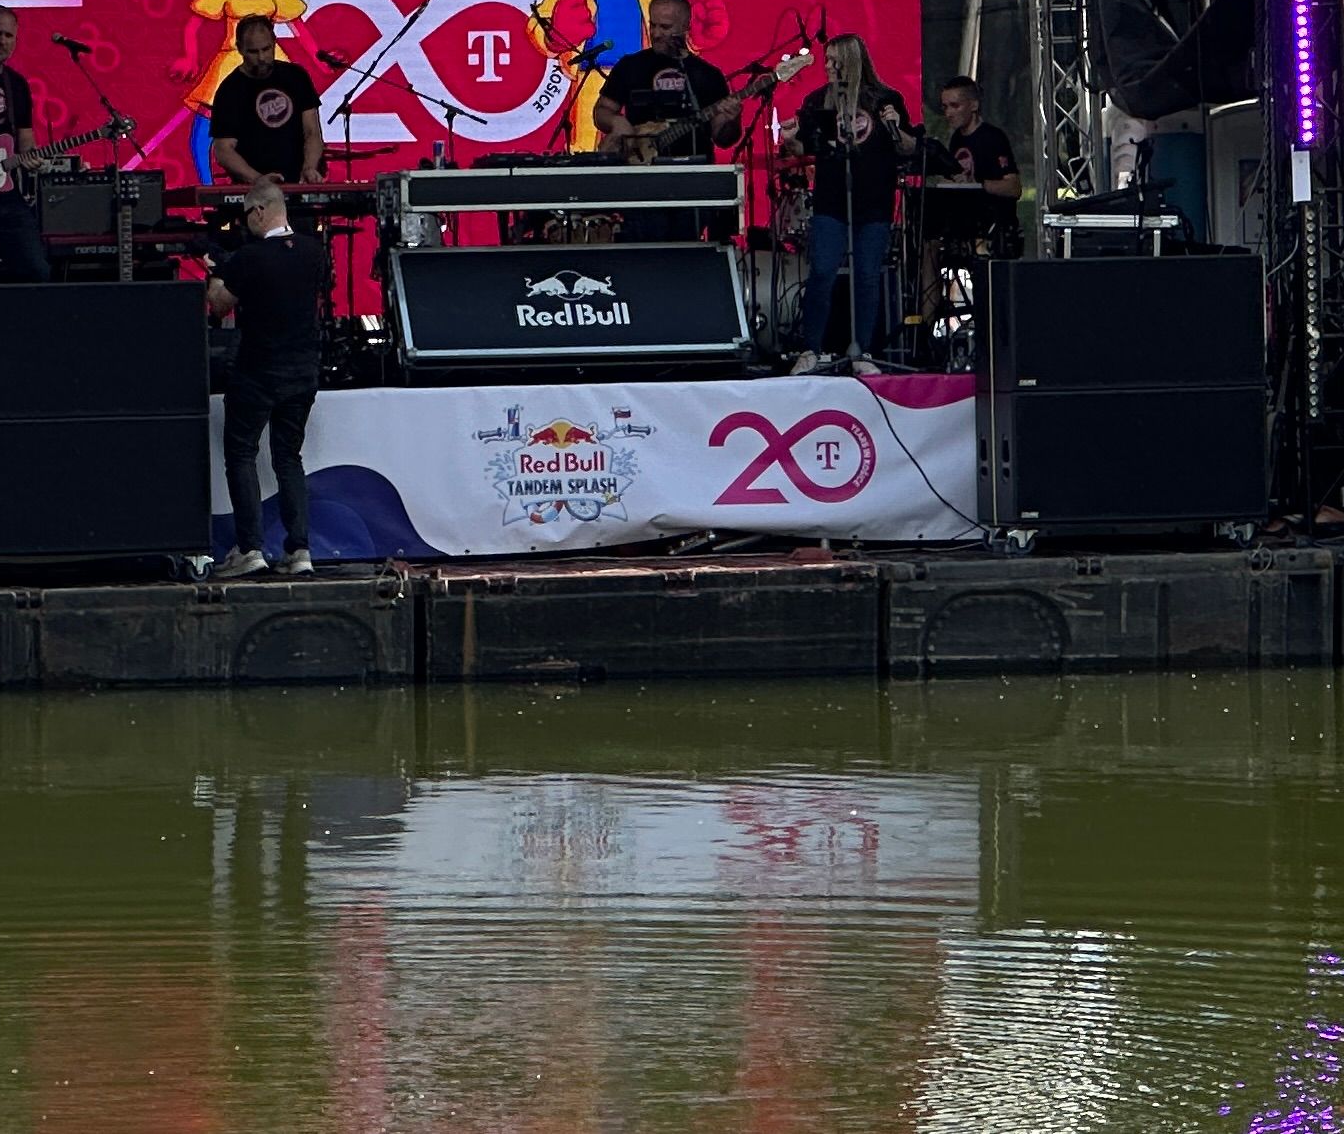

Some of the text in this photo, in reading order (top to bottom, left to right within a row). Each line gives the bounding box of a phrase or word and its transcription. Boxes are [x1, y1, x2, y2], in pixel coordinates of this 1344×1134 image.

[467, 30, 511, 82] T
[532, 65, 564, 114] KOŠICE
[516, 302, 631, 327] Red Bull
[520, 450, 605, 474] Red Bull
[708, 409, 877, 506] 20
[815, 441, 841, 470] T
[507, 477, 618, 496] TANDEM SPLASH
